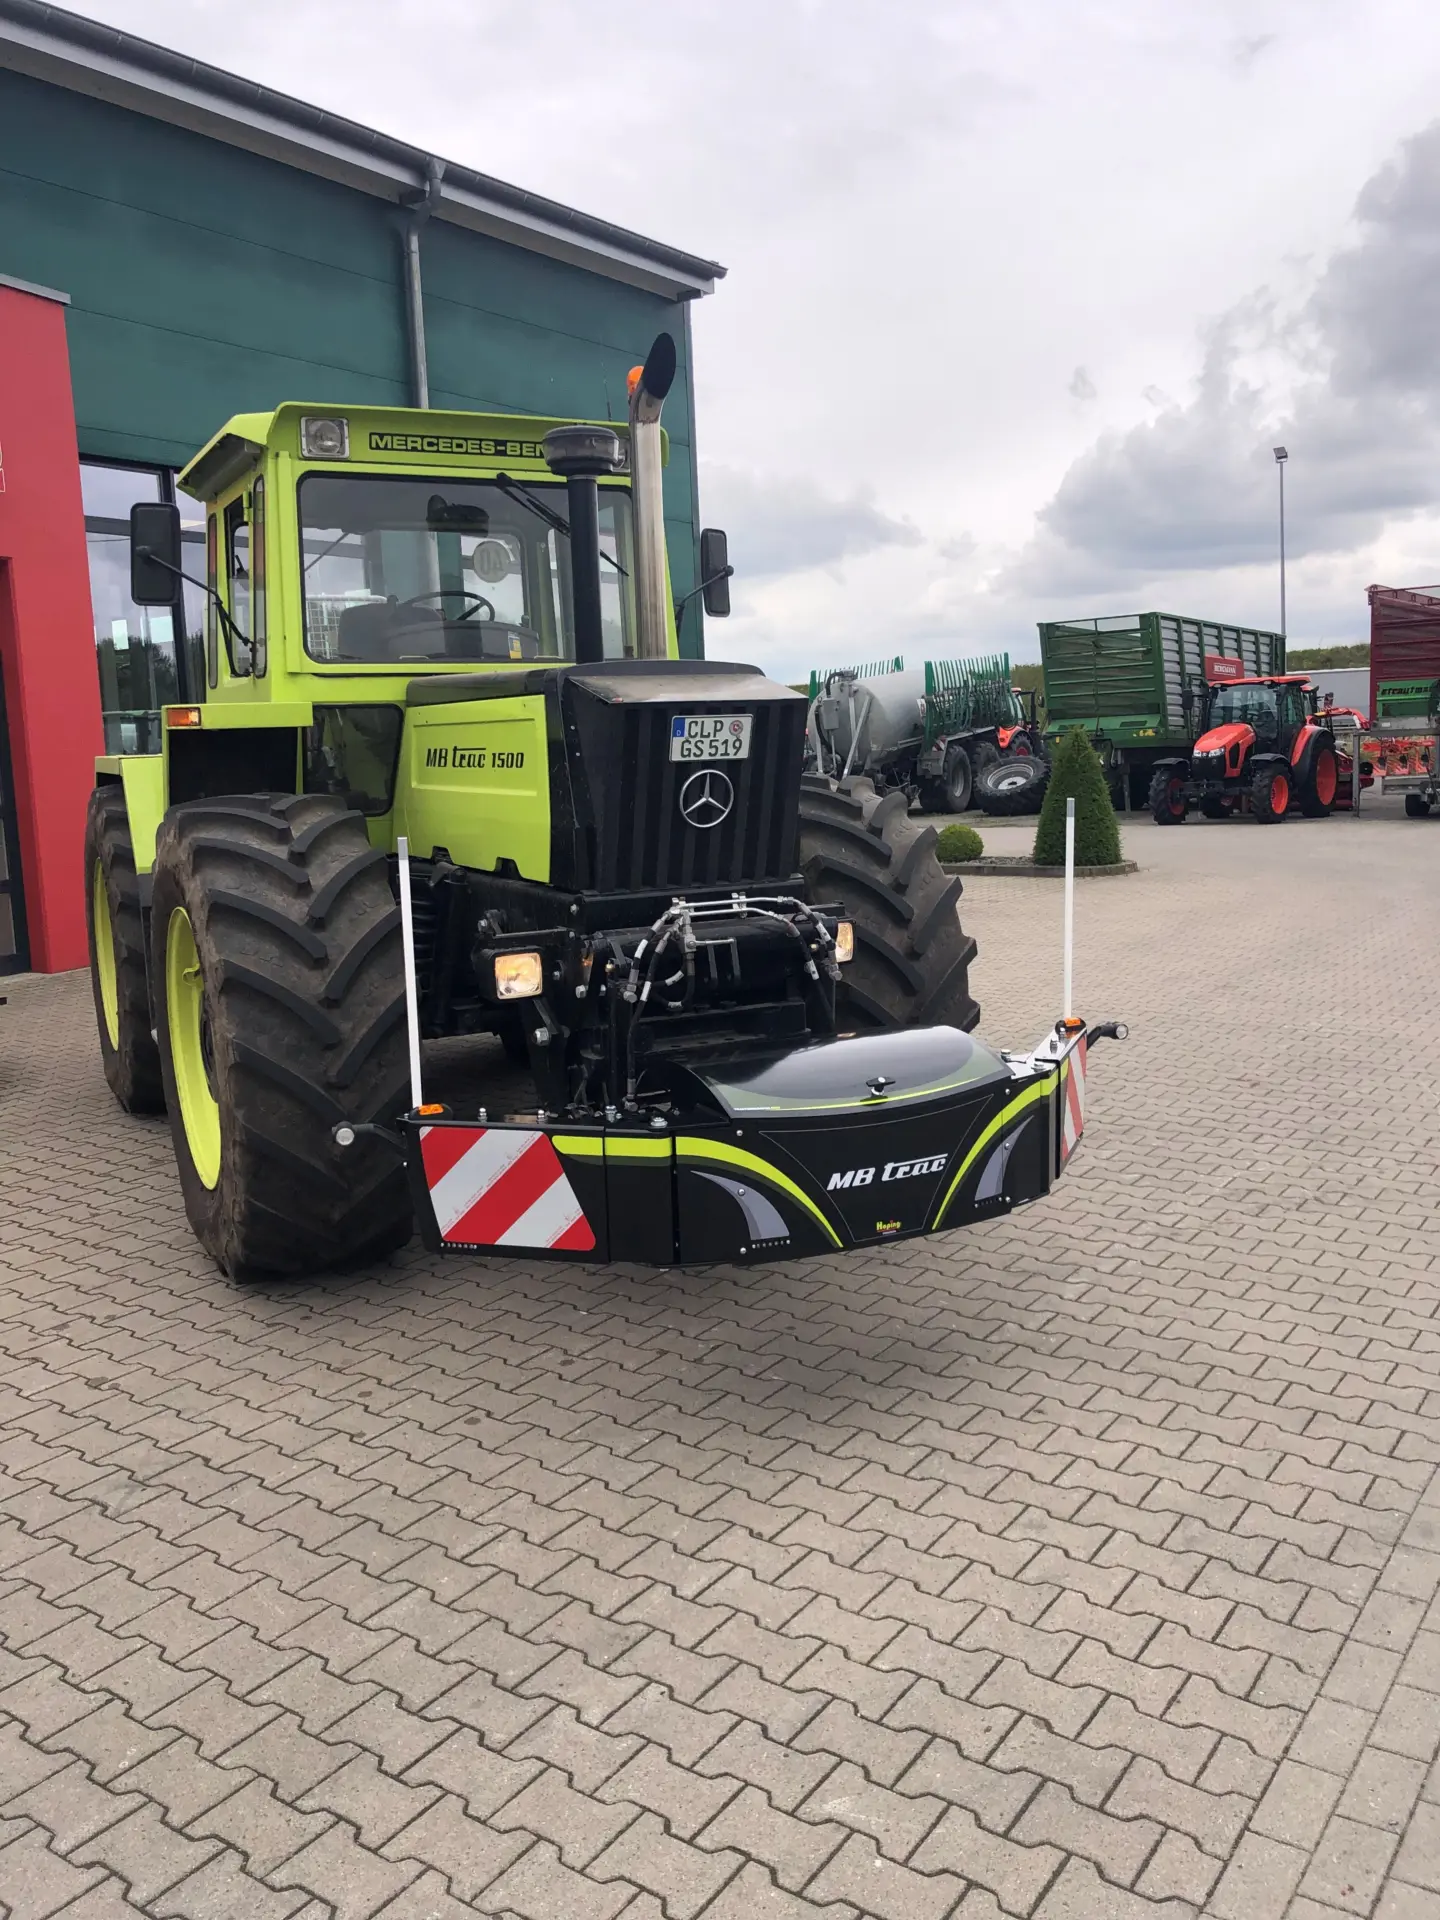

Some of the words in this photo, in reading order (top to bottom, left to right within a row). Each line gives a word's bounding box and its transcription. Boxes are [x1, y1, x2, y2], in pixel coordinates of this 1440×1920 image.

[371, 435, 545, 457] MERCEDES-BEN
[676, 729, 682, 737] D
[687, 719, 724, 739] CLP
[426, 747, 448, 768] MB
[452, 745, 487, 769] trac
[491, 752, 525, 769] 1500
[680, 740, 704, 758] GS
[708, 738, 743, 757] 519
[826, 1167, 876, 1191] MB
[881, 1152, 949, 1182] trac
